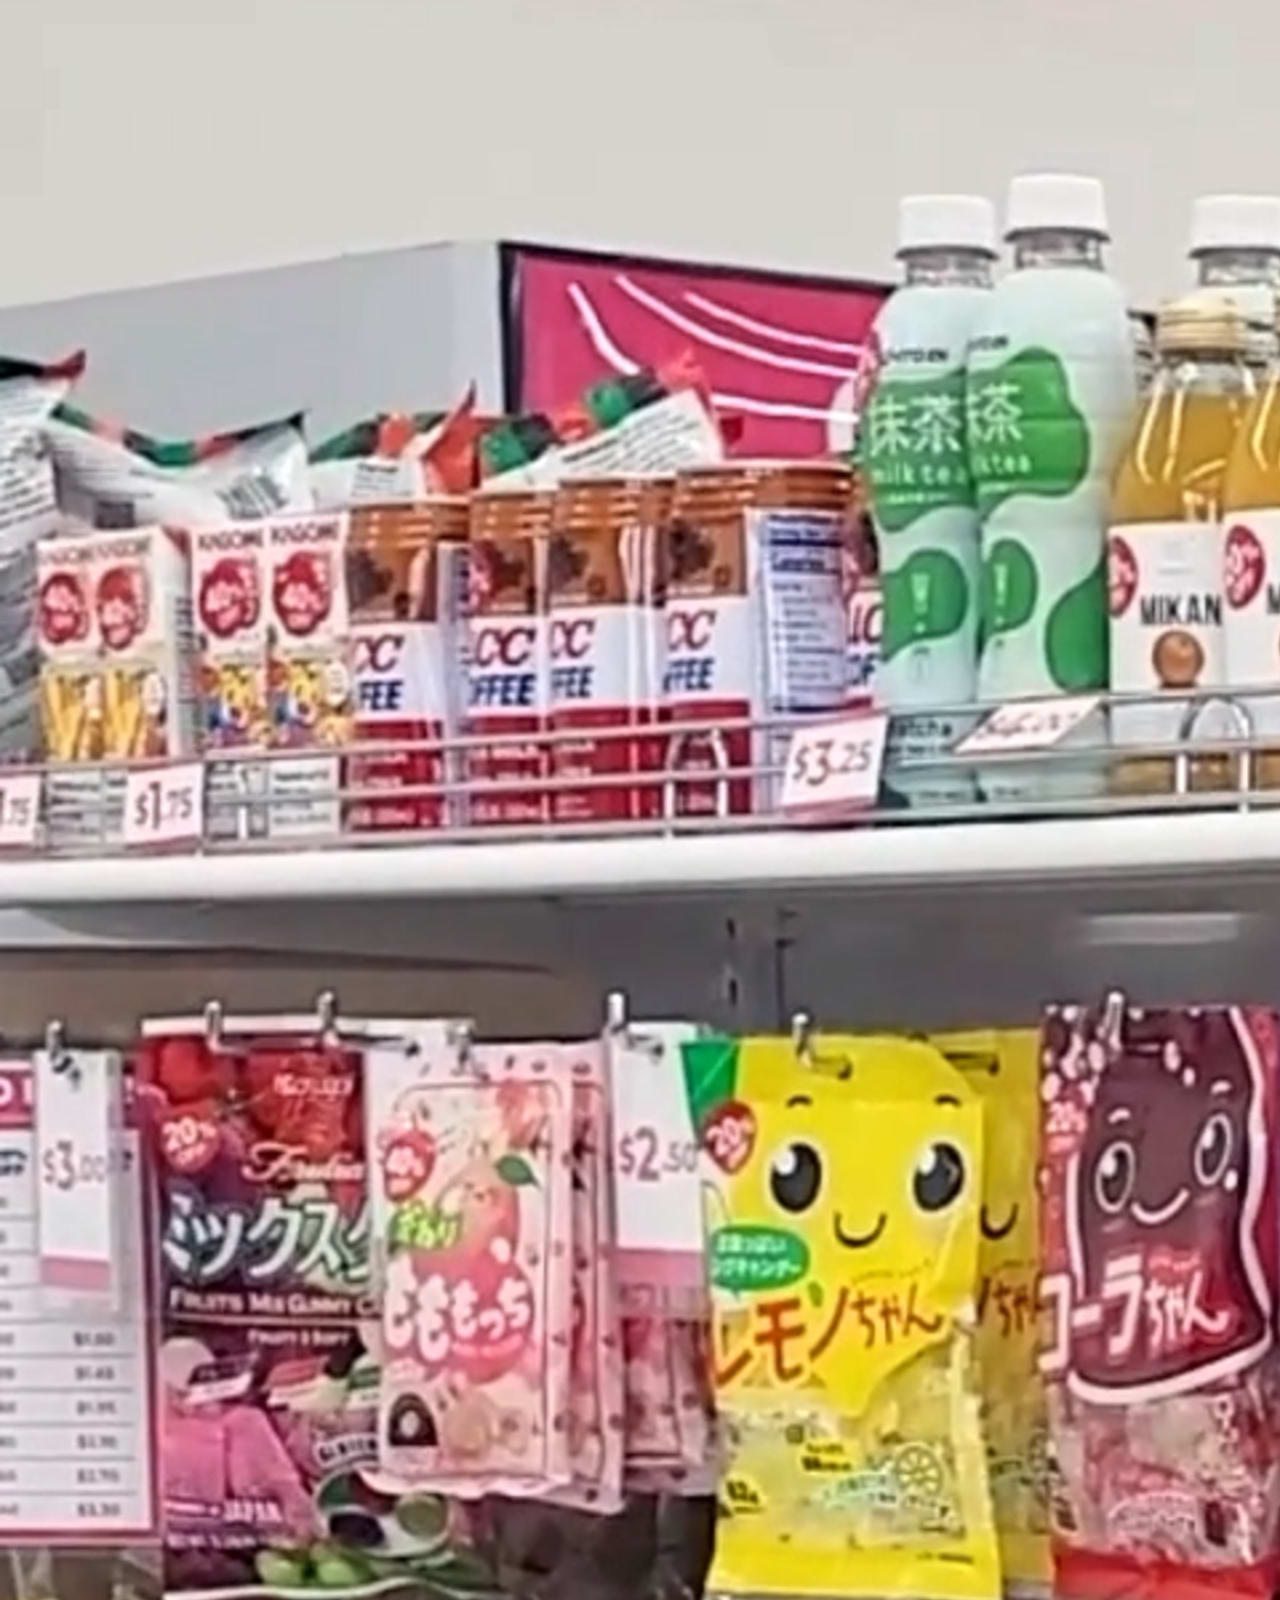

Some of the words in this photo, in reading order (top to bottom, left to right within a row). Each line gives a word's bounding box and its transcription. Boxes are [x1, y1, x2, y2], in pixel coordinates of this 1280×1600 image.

[1140, 596, 1222, 626] MIKAN
[793, 738, 872, 786] $3.25
[134, 781, 194, 831] $1.75
[618, 1126, 698, 1182] $2.50
